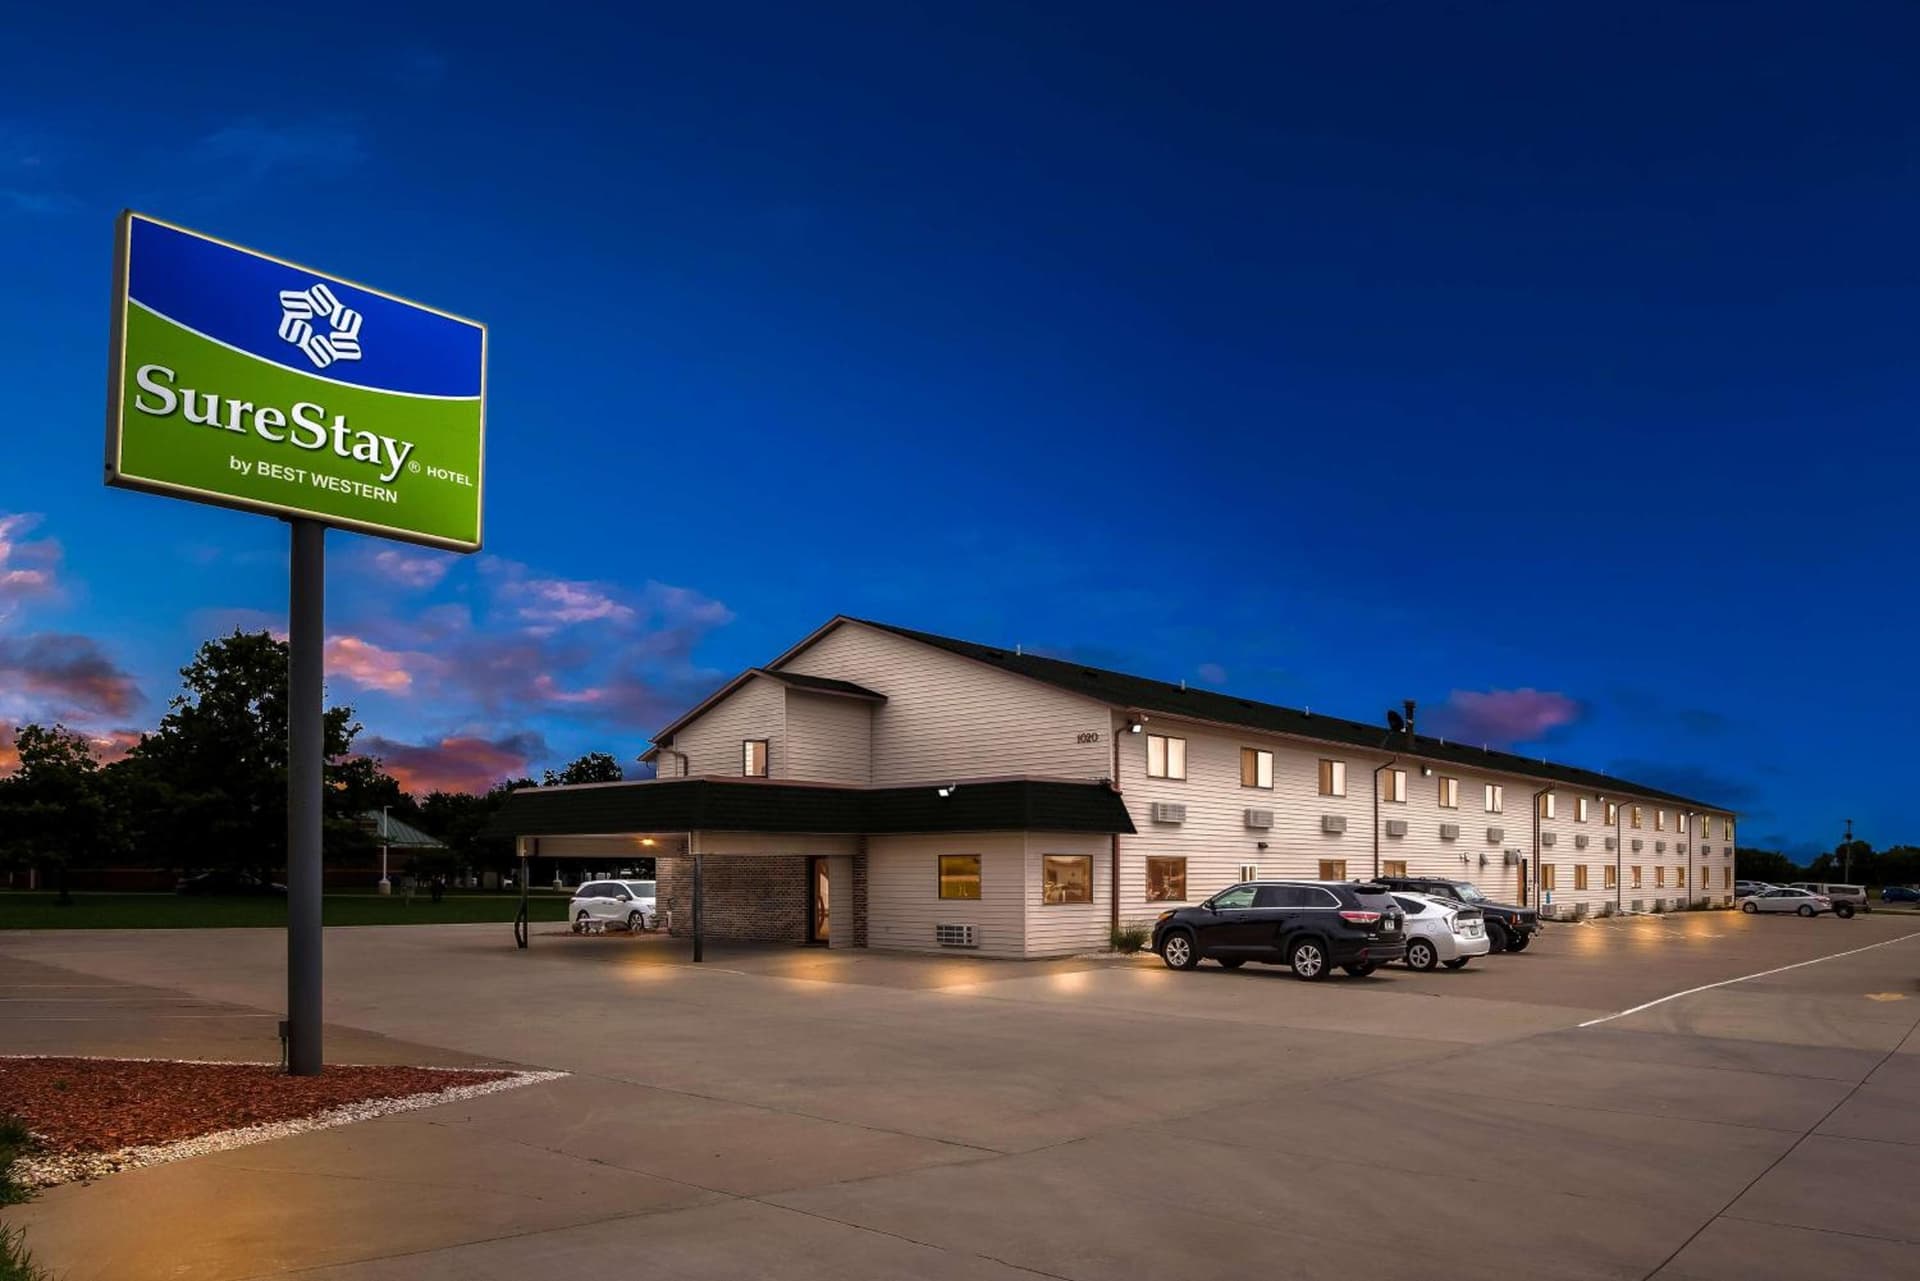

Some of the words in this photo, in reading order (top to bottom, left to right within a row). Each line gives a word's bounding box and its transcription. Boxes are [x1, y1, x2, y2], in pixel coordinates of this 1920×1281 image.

[135, 364, 414, 482] SureStay
[426, 465, 473, 487] HOTEL
[229, 455, 252, 476] by
[257, 461, 307, 484] BEST
[311, 472, 398, 504] WESTERN
[1077, 732, 1099, 744] 1020
